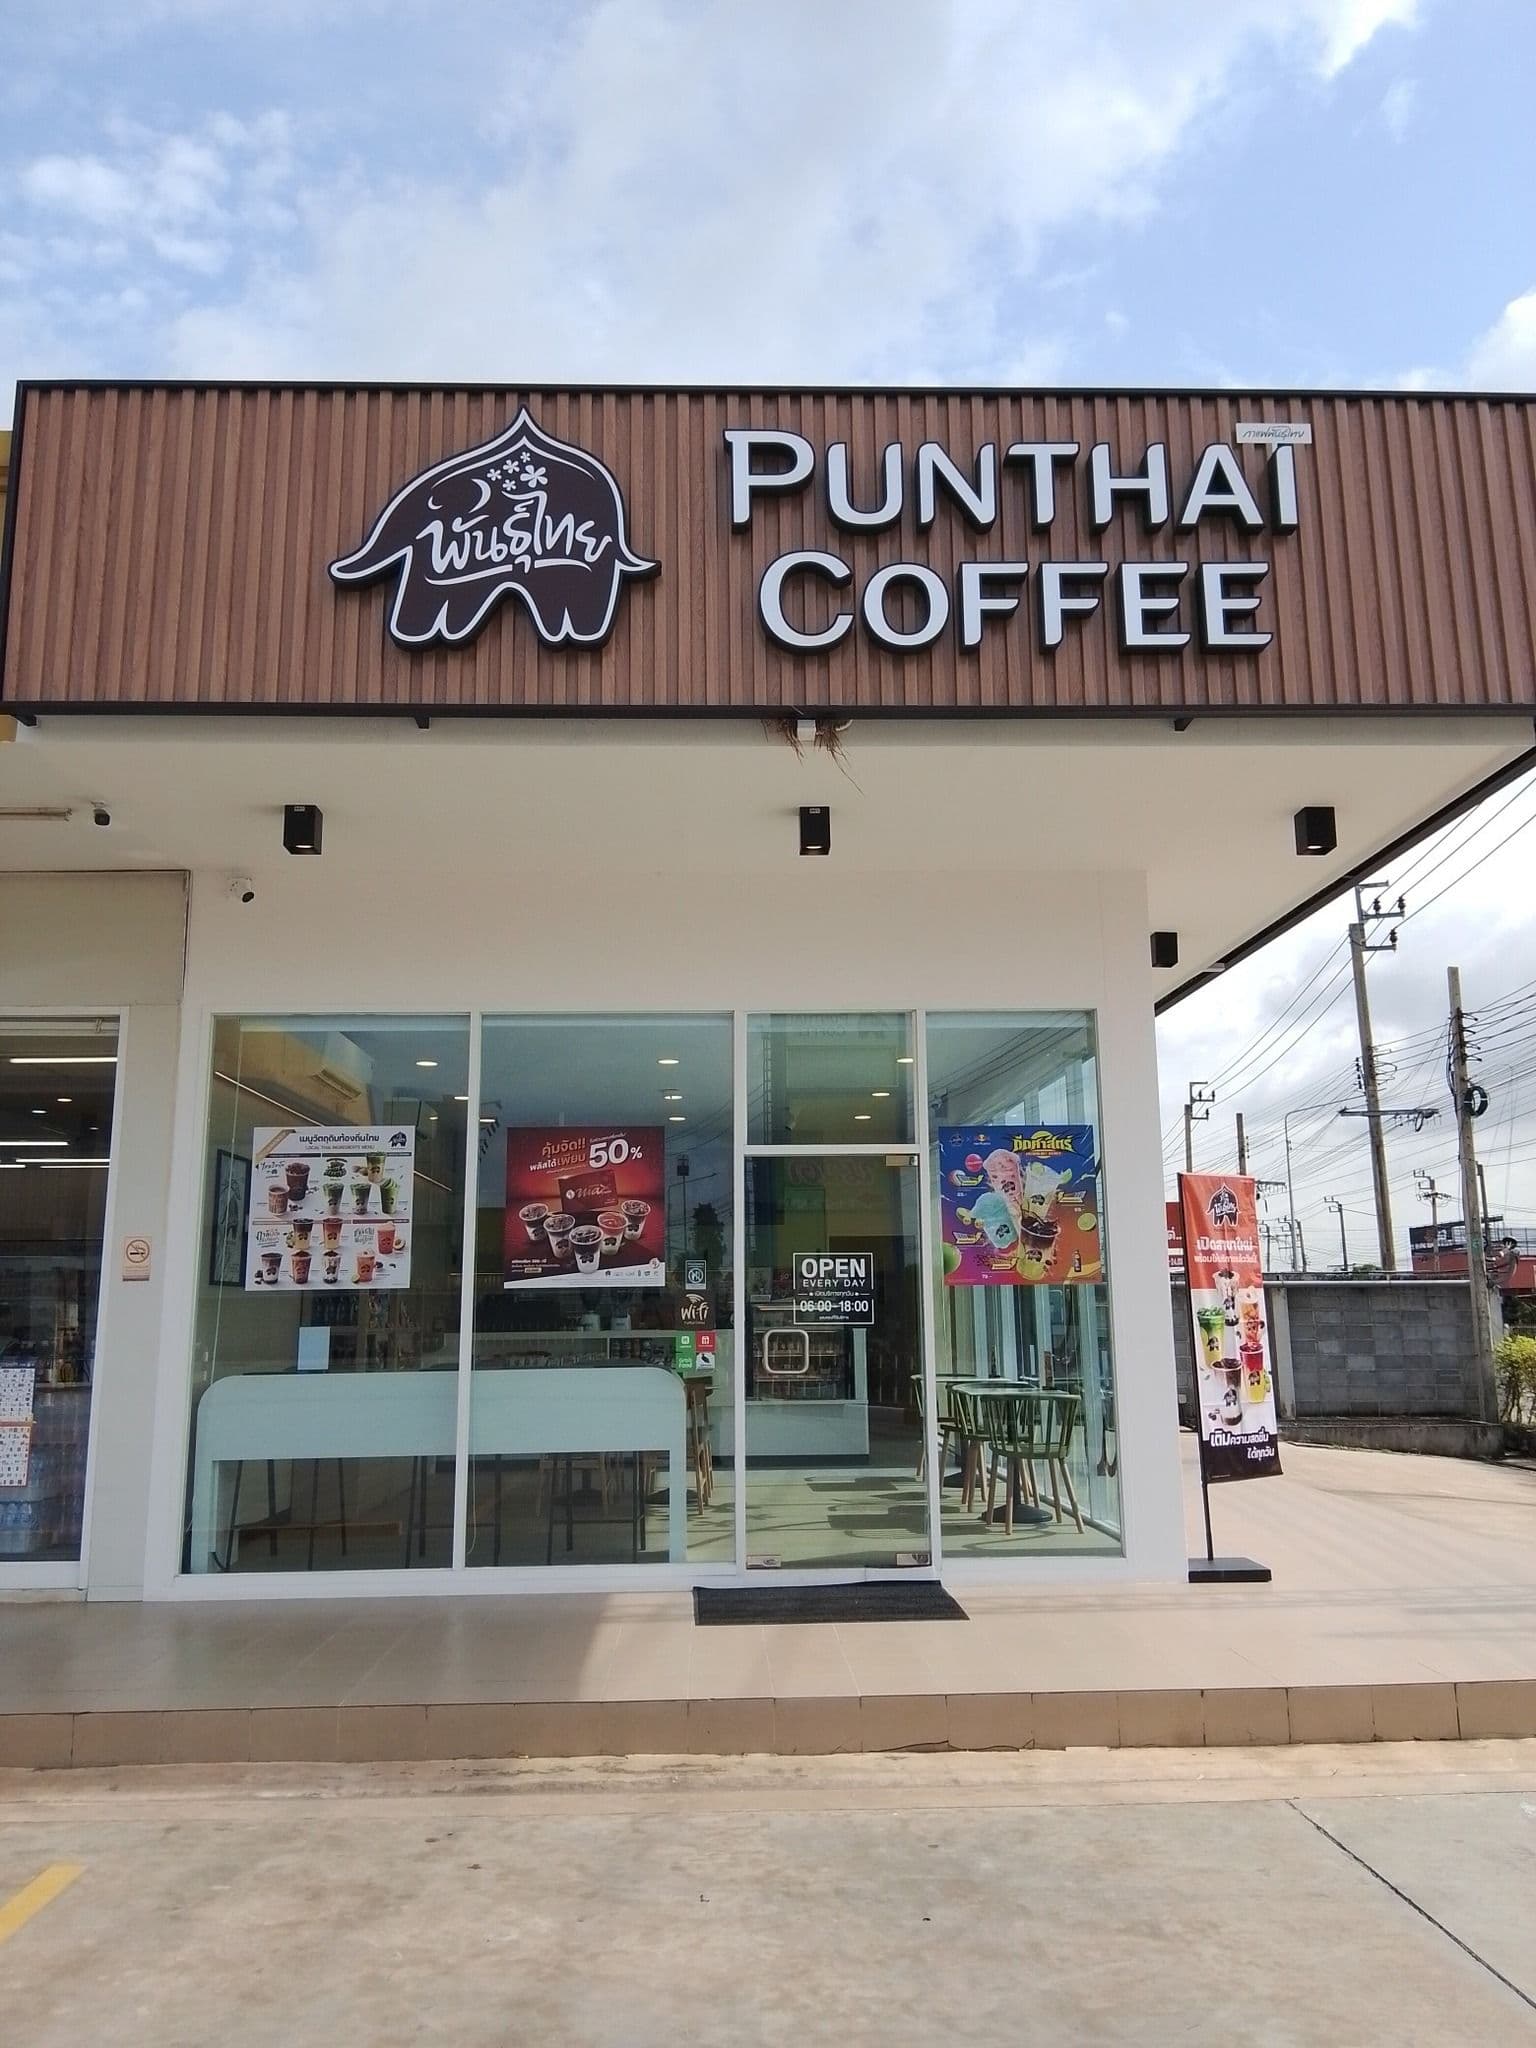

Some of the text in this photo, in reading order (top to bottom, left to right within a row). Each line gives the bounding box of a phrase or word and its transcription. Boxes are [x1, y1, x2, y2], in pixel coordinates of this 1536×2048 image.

[724, 429, 1298, 527] PUNTHAI
[415, 489, 613, 574] พันธุ์ไทย
[759, 550, 1273, 648] COFFEE
[801, 1258, 866, 1278] OPEN
[1196, 1236, 1253, 1251] เปิดสาขาใหม่
[803, 1279, 866, 1288] EVERY DAY
